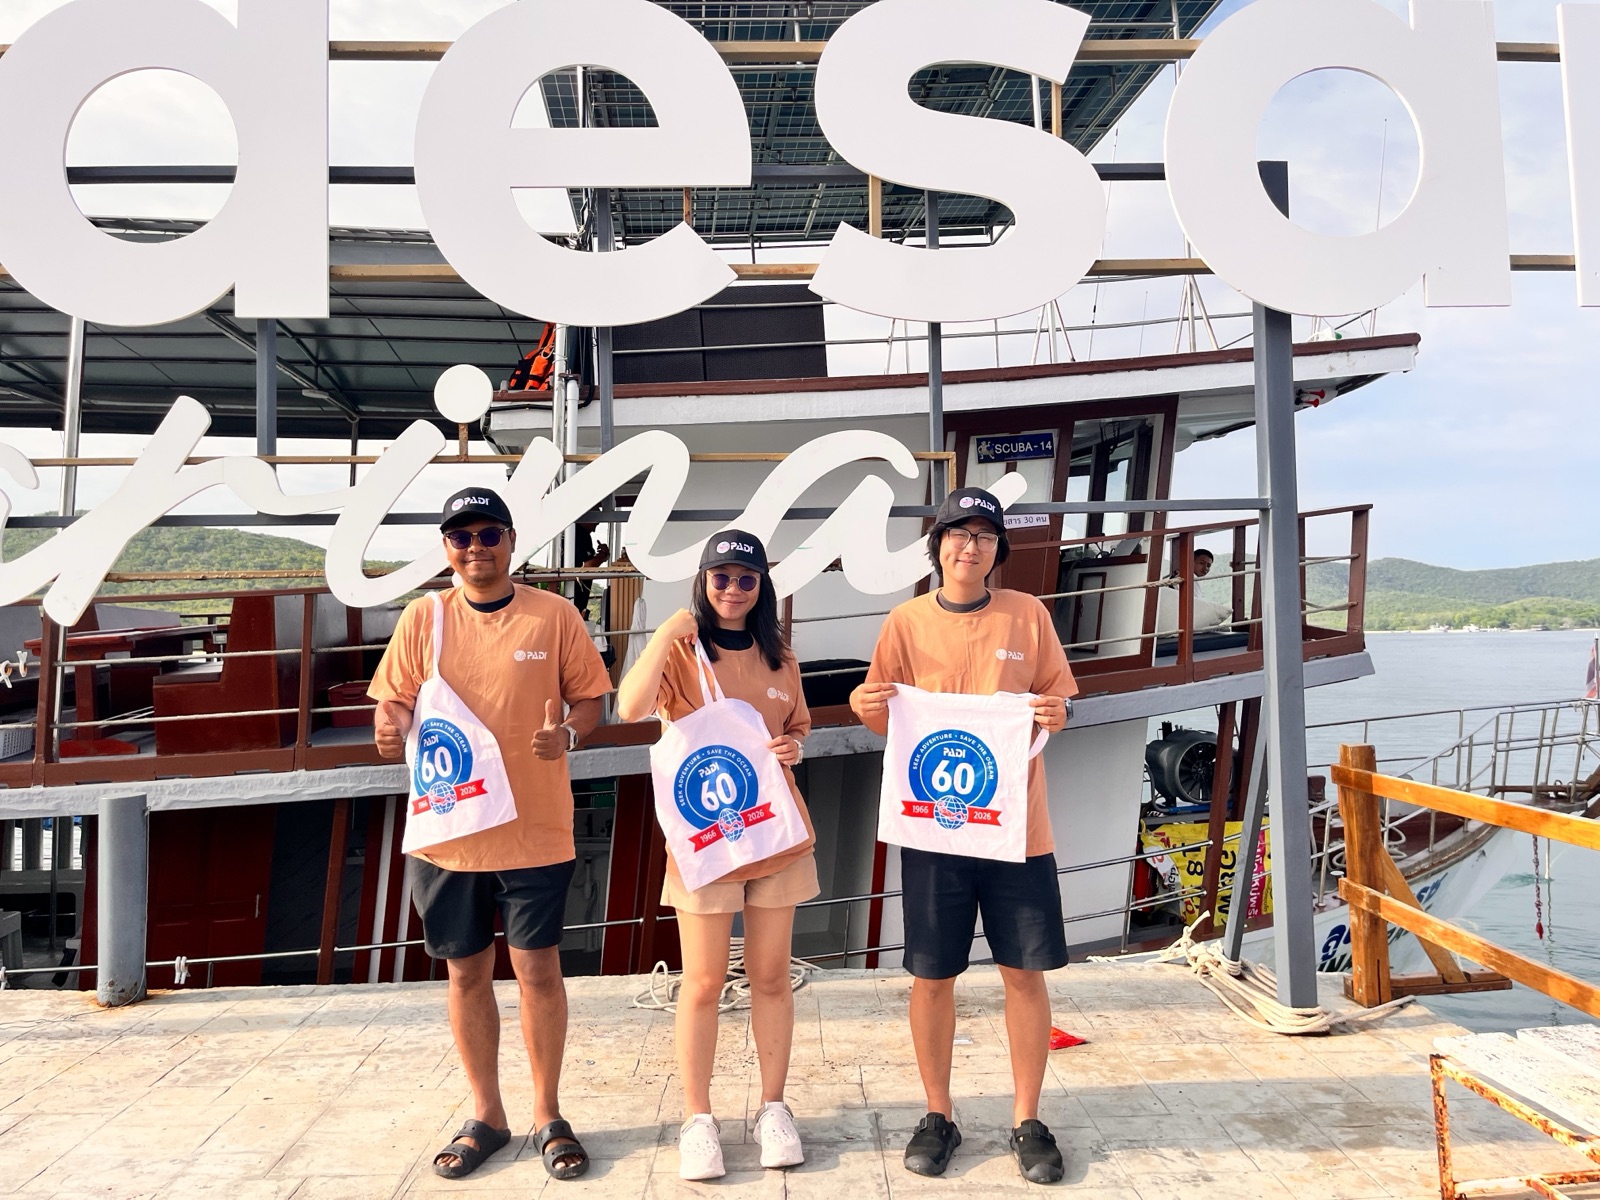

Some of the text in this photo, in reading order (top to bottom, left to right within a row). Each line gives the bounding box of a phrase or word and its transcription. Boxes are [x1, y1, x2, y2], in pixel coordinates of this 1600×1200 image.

[994, 440, 1052, 454] SCUBA-14
[0, 365, 1027, 628] rina
[464, 496, 490, 506] PADI
[974, 498, 996, 513] PADI
[730, 541, 755, 554] PADI
[527, 651, 548, 660] PADI
[1007, 650, 1024, 661] PADI
[777, 690, 789, 702] PADI
[423, 734, 439, 747] PADI
[444, 724, 455, 734] THE
[454, 732, 468, 753] OCEAN
[912, 733, 994, 780] SEEK ADVENTURE SAVE THE OCEAN
[943, 747, 966, 758] PADI
[421, 746, 453, 783] 60
[698, 761, 719, 778] PADI
[678, 748, 752, 807] SEEK ADVENTURE SAVE THE OCEAN
[931, 759, 975, 795] 60
[459, 784, 477, 796] 2026
[701, 772, 738, 811] 60
[912, 805, 992, 820] 1966 2026
[700, 809, 765, 843] 1966 2026
